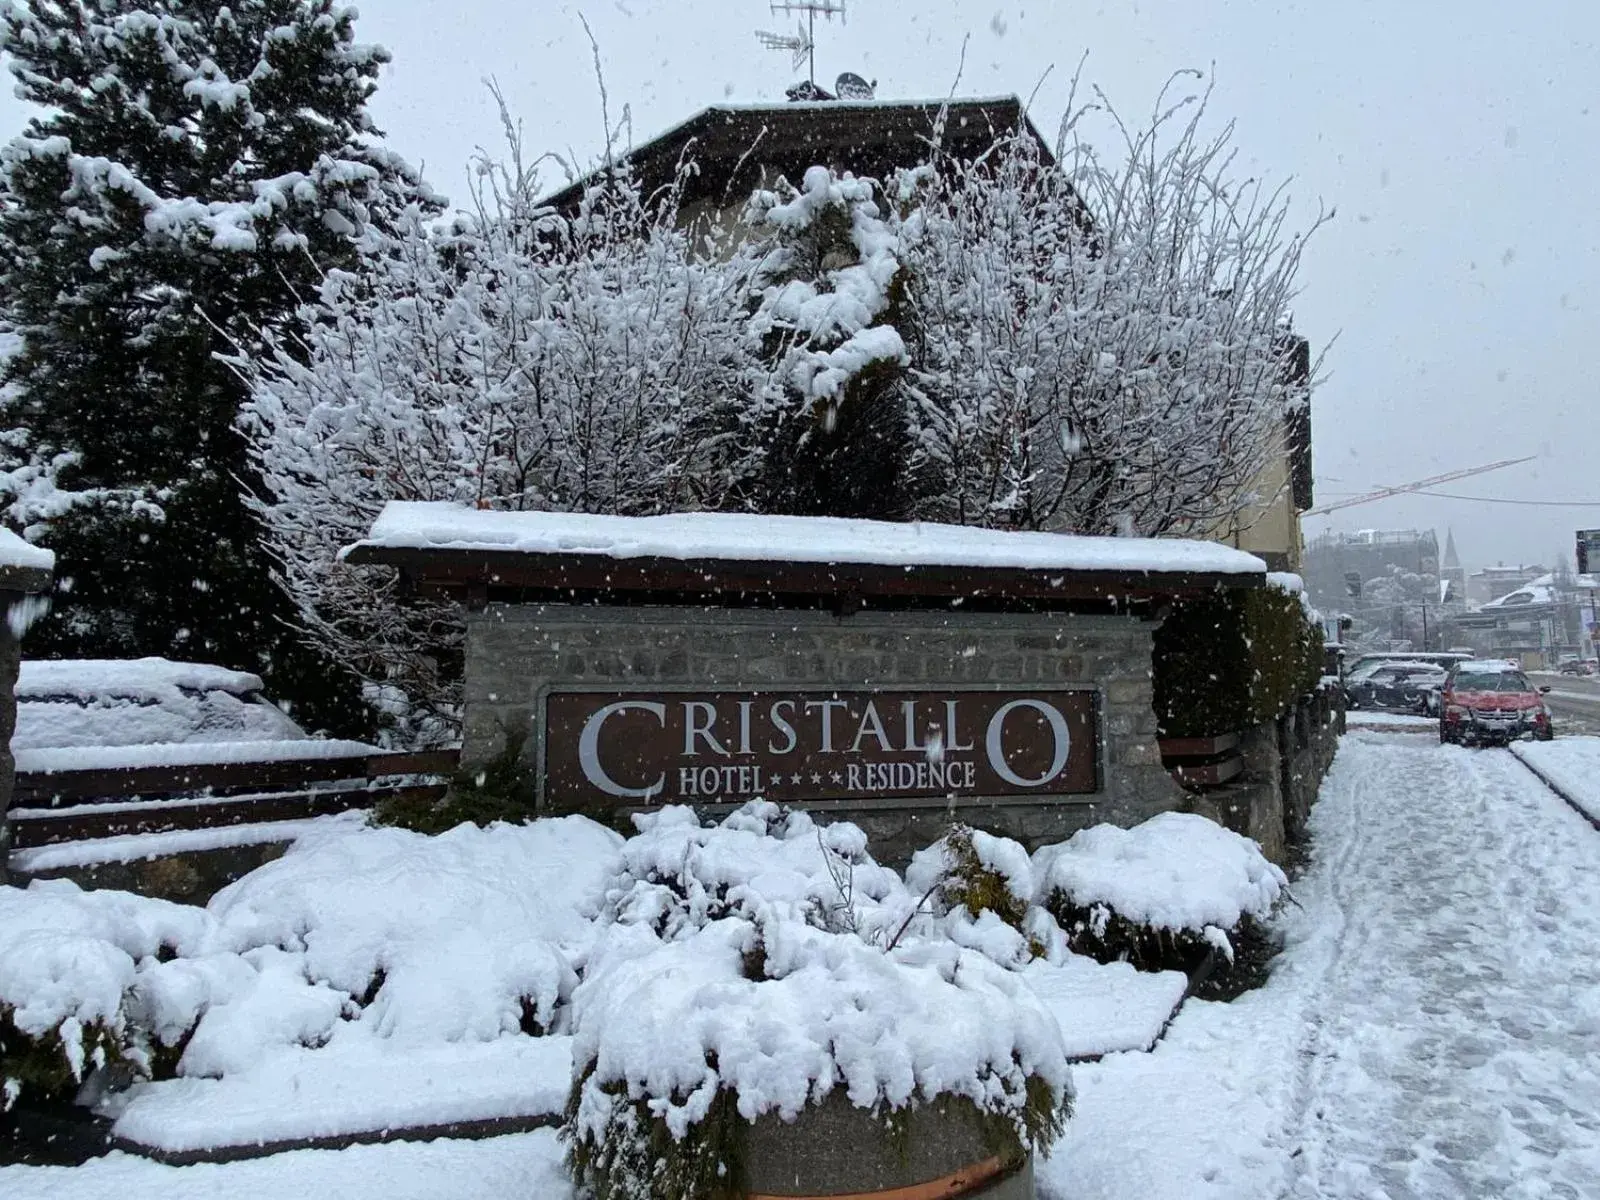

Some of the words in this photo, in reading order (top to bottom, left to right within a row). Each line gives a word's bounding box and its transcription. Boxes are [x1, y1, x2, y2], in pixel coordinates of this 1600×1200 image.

[579, 699, 1070, 797] CRISTALLO
[679, 765, 765, 795] HOTEL
[847, 761, 976, 791] RESIDENCE
